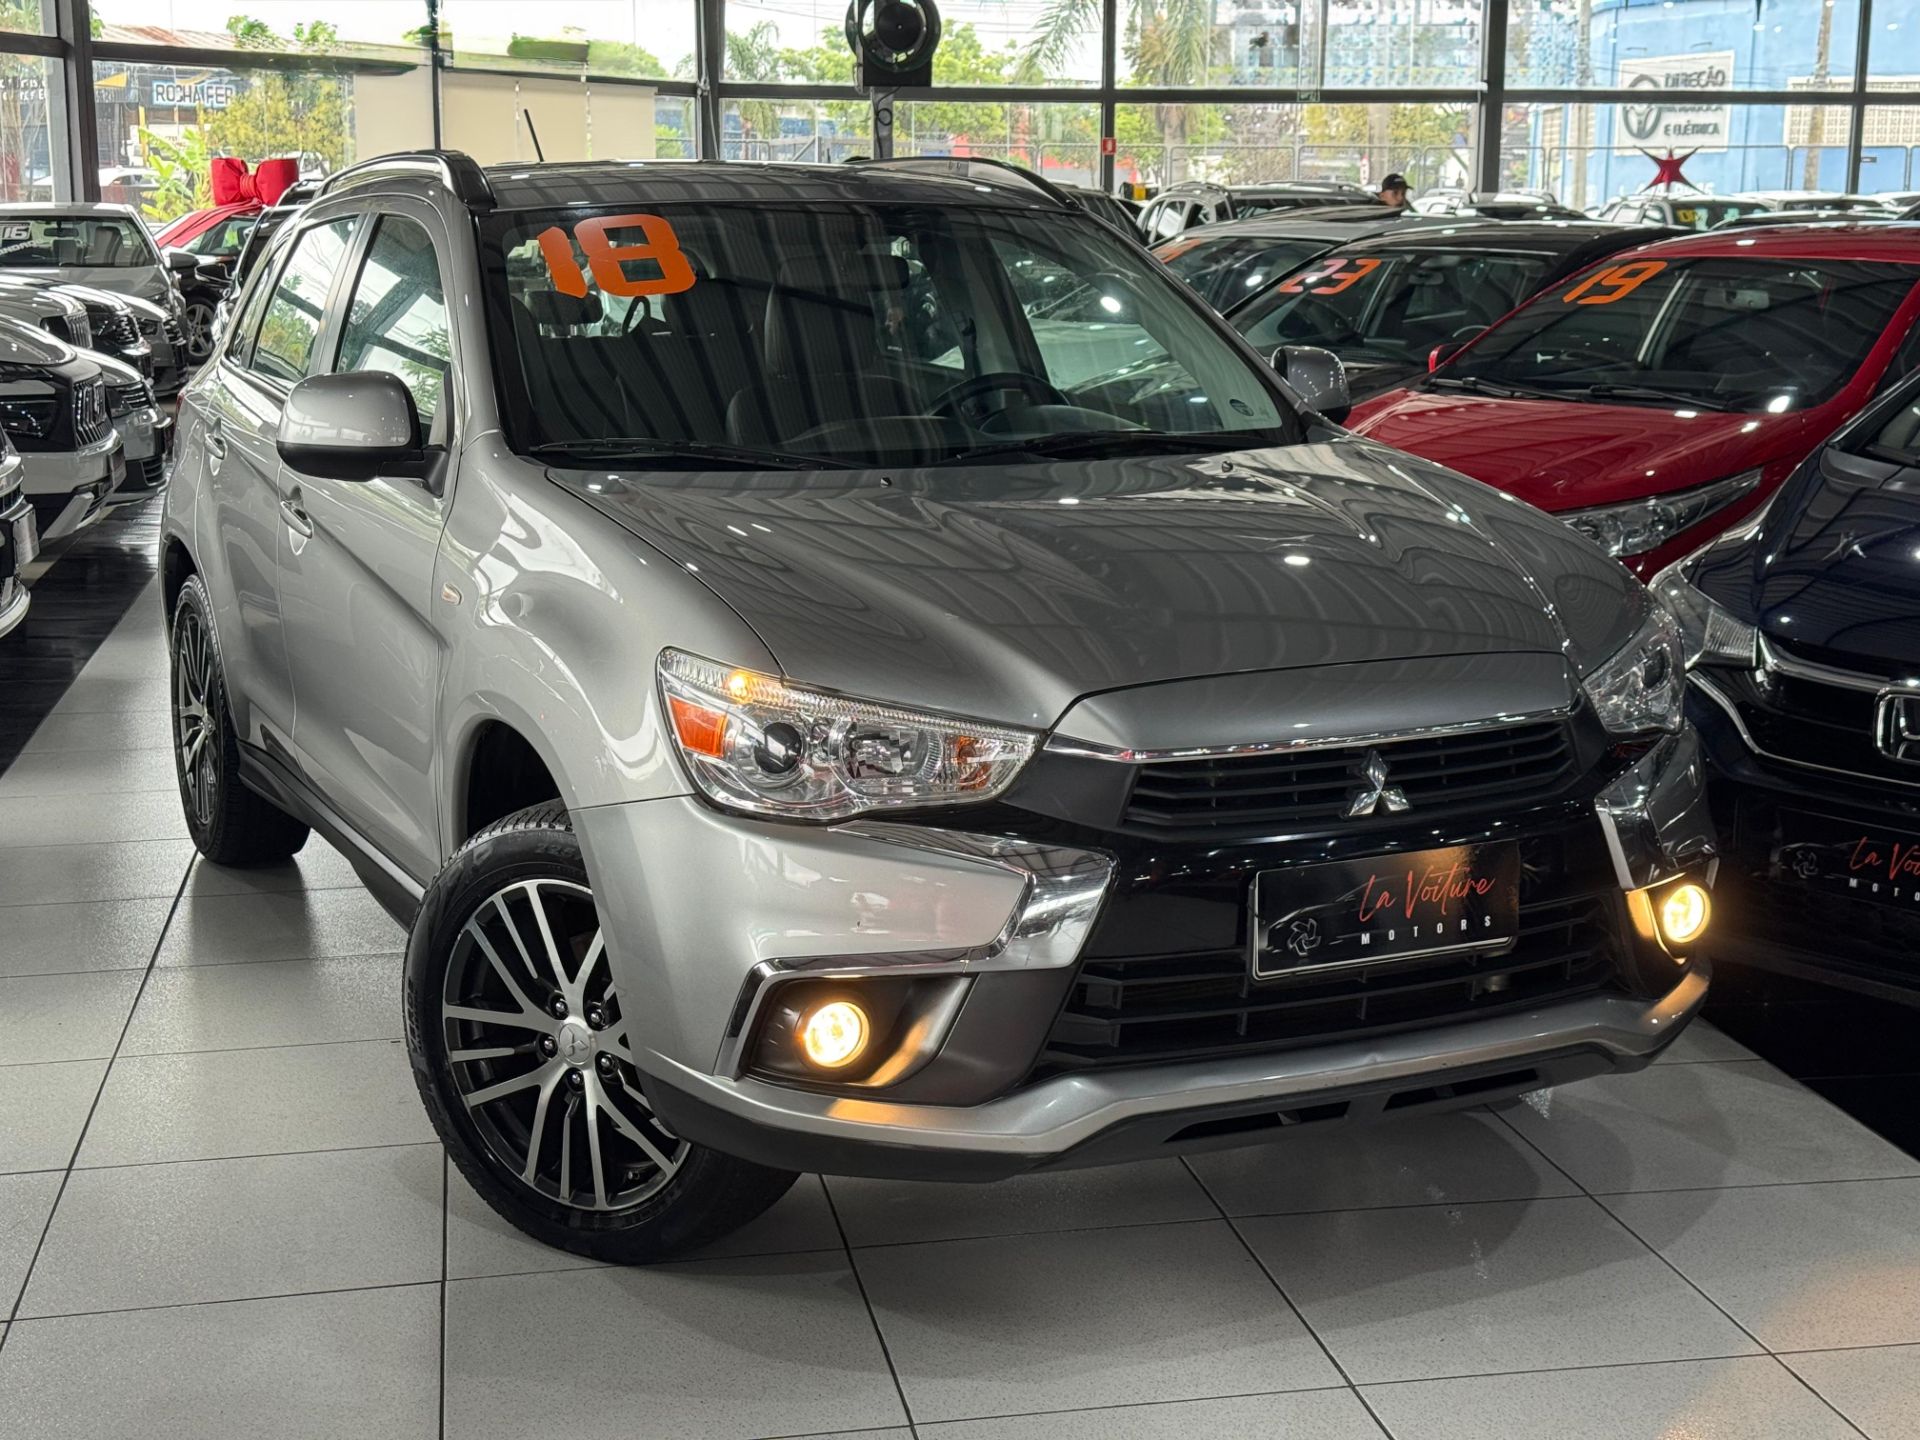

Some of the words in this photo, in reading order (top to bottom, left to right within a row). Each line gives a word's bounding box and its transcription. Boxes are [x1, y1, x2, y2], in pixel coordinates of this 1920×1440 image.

[1664, 65, 1726, 88] DIREÇÃO
[4, 224, 28, 239] 16
[537, 213, 697, 299] 18
[1279, 258, 1382, 294] 23
[1562, 260, 1668, 304] 19
[1849, 836, 1883, 870] La
[1359, 874, 1396, 922] La
[1404, 862, 1495, 919] Voiture
[1361, 915, 1491, 945] MOTORS
